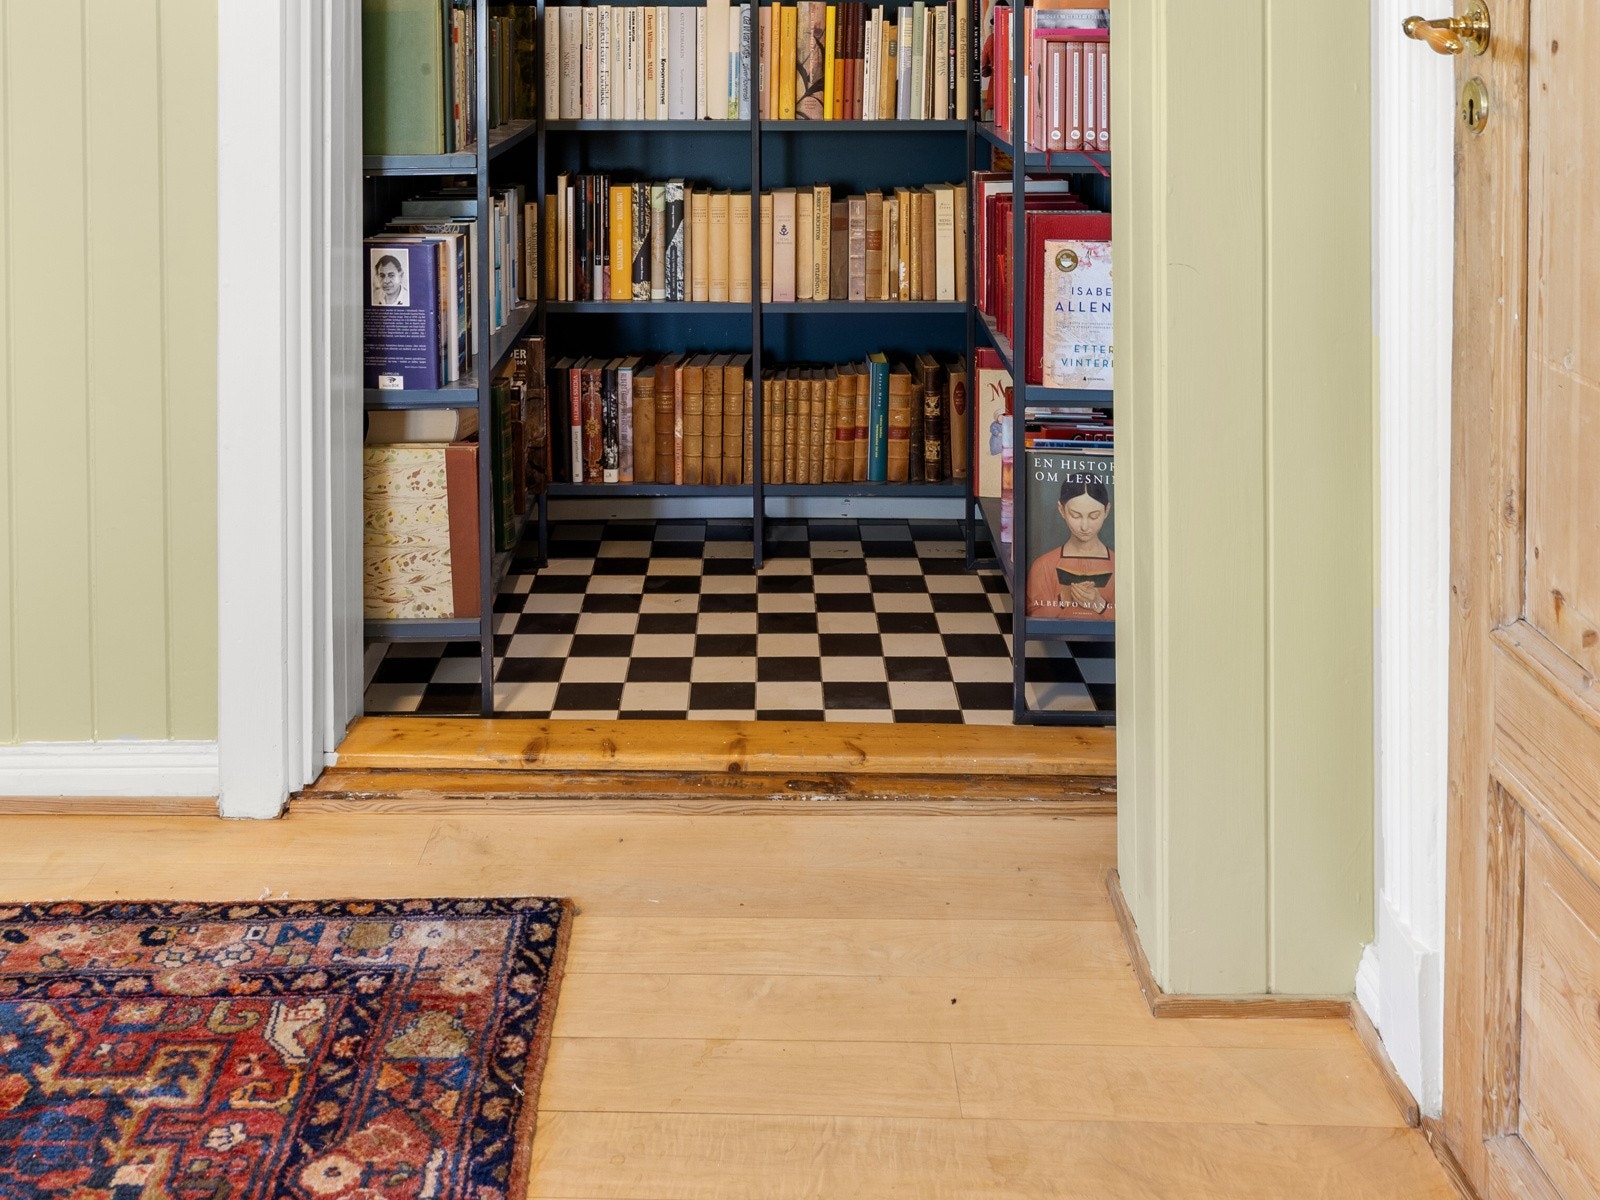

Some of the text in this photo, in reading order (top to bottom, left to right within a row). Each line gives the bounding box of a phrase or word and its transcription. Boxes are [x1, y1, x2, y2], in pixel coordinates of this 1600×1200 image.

[938, 10, 946, 23] Jens
[822, 191, 830, 214] Santa
[822, 215, 830, 246] Vittorias
[1074, 345, 1114, 354] ETTER
[1034, 458, 1053, 468] EN
[1036, 472, 1058, 482] OM
[1033, 600, 1079, 609] ALBERTO
